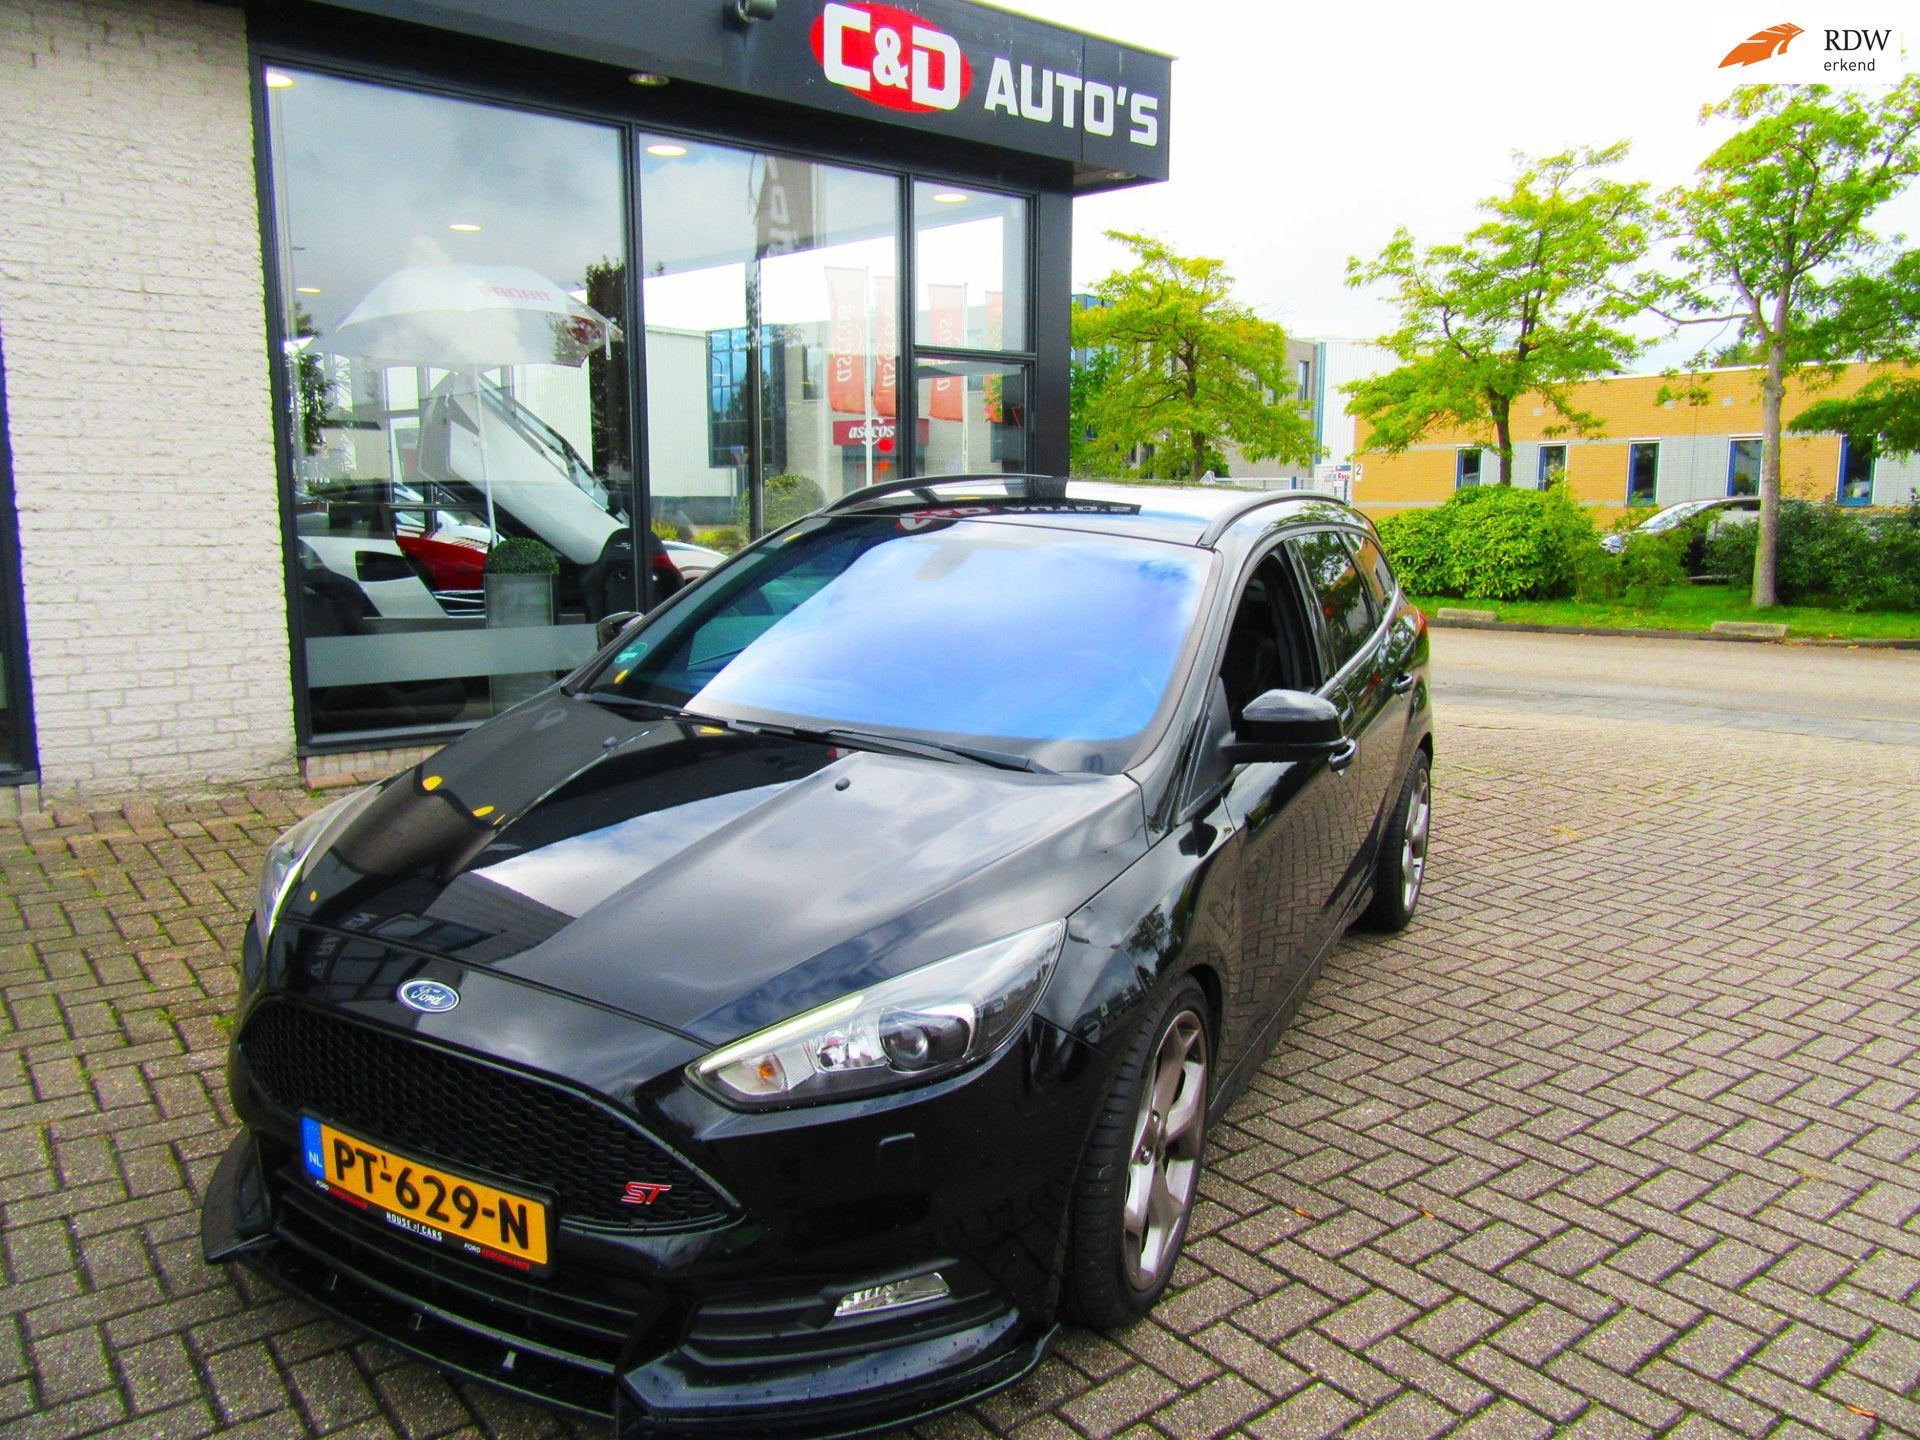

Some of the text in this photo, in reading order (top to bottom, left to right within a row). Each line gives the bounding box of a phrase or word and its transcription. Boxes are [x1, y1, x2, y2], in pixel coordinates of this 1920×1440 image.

[823, 2, 1158, 147] C&D AUTO'S
[1356, 463, 1362, 476] 2
[410, 985, 446, 1006] Ford
[308, 1150, 323, 1168] NL
[621, 1181, 673, 1205] ST
[385, 1211, 411, 1230] HOUSE
[421, 1225, 443, 1242] CARS
[464, 1242, 481, 1254] FORD
